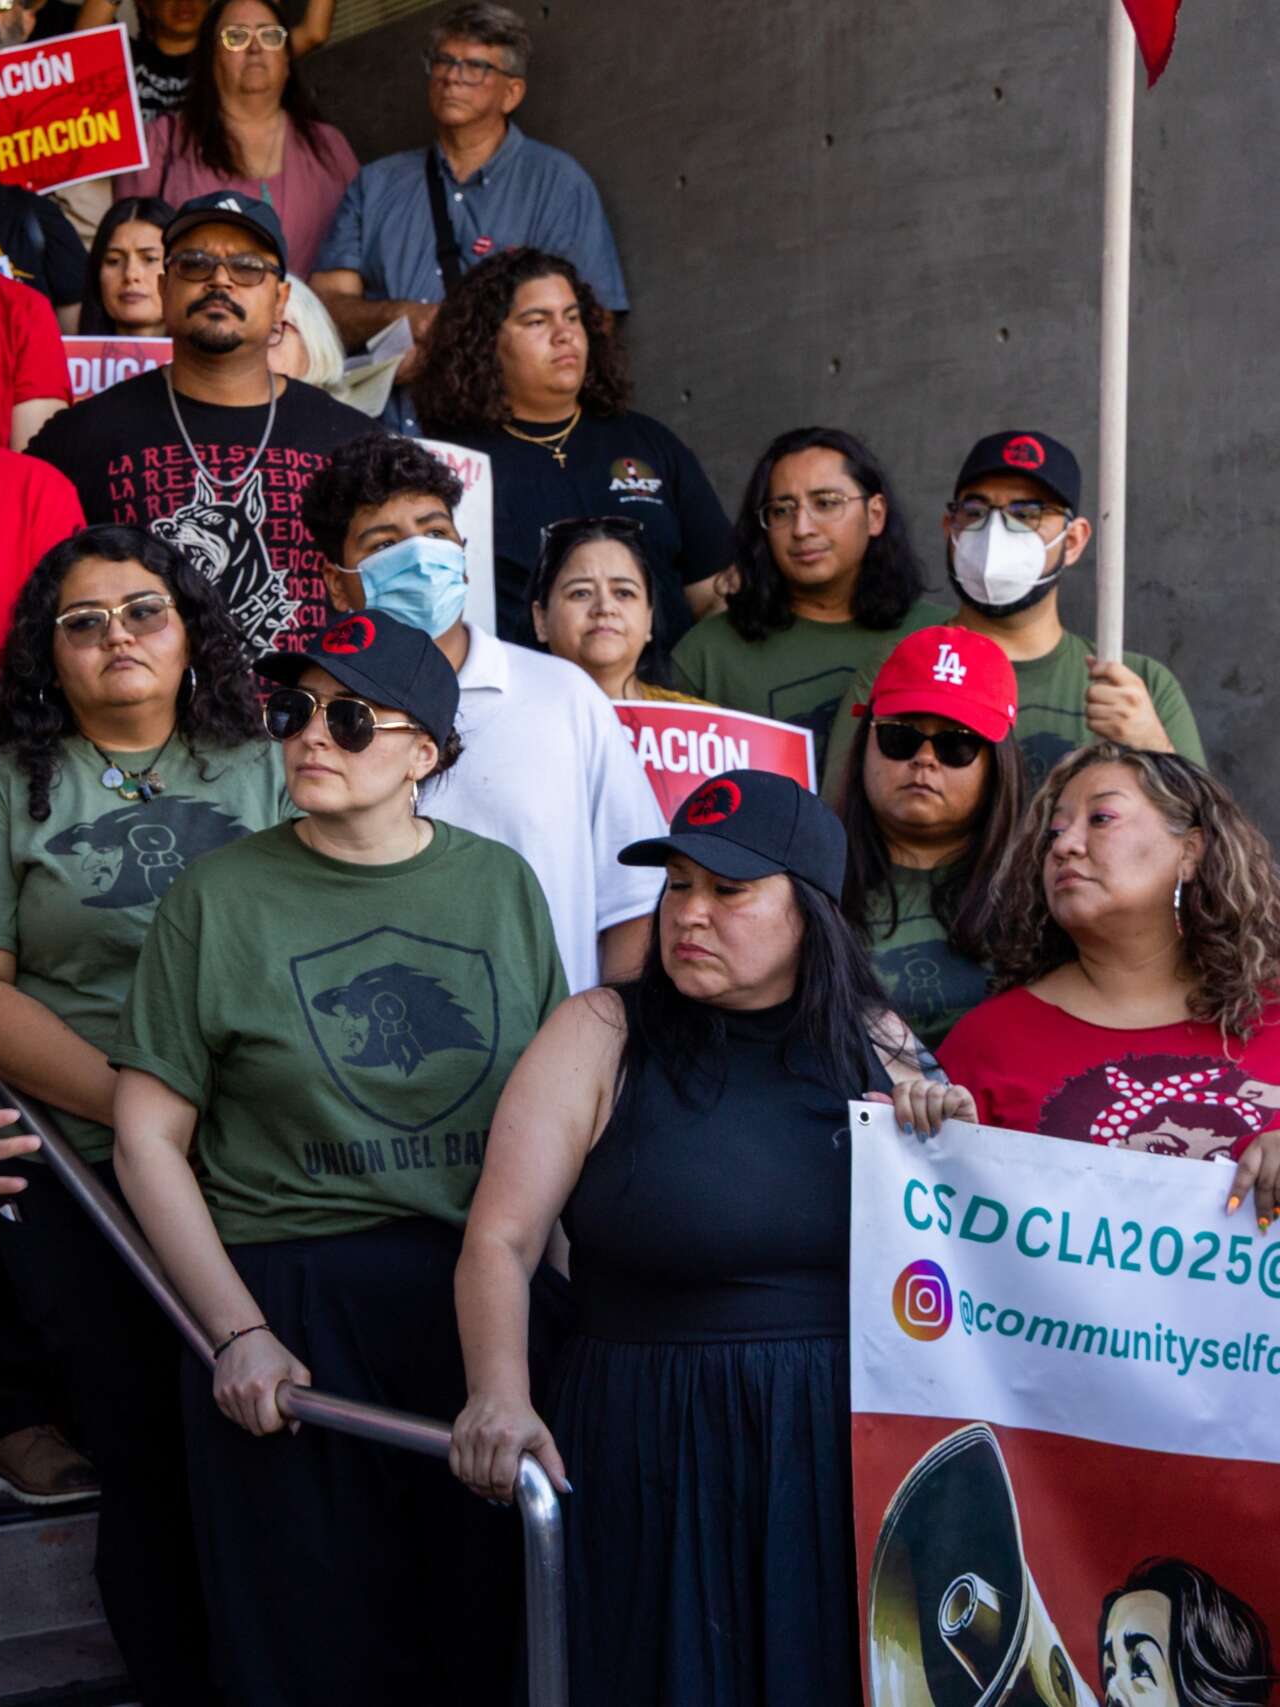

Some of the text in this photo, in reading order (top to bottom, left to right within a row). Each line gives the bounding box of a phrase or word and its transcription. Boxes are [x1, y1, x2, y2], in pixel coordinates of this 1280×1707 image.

[107, 454, 134, 475] LA
[932, 644, 967, 687] LA
[304, 1130, 490, 1176] UNION DEL BA
